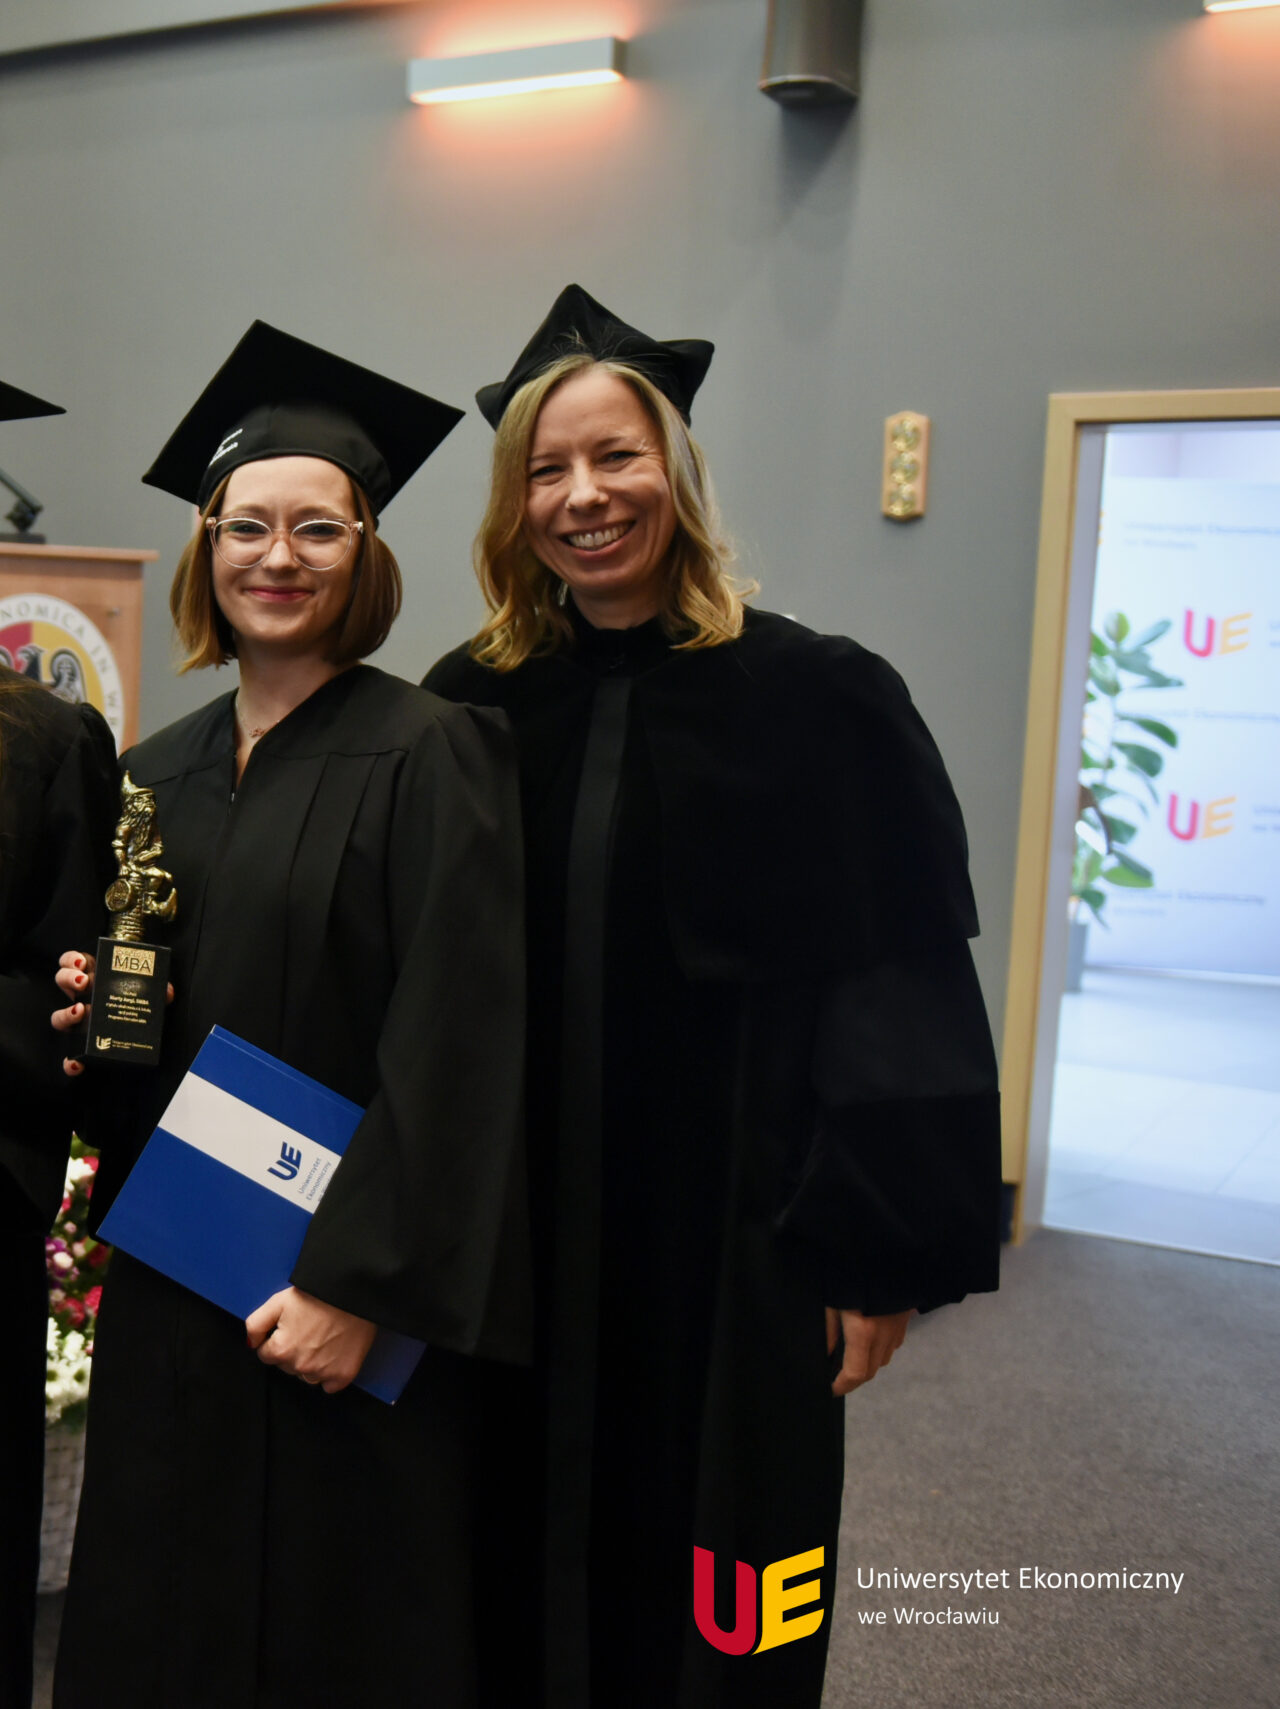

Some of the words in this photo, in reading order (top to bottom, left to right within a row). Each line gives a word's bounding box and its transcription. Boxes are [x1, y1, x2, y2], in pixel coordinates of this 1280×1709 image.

[1183, 608, 1253, 658] UE
[1167, 793, 1237, 841] UE
[114, 955, 151, 973] MBA
[266, 1141, 302, 1181] UE
